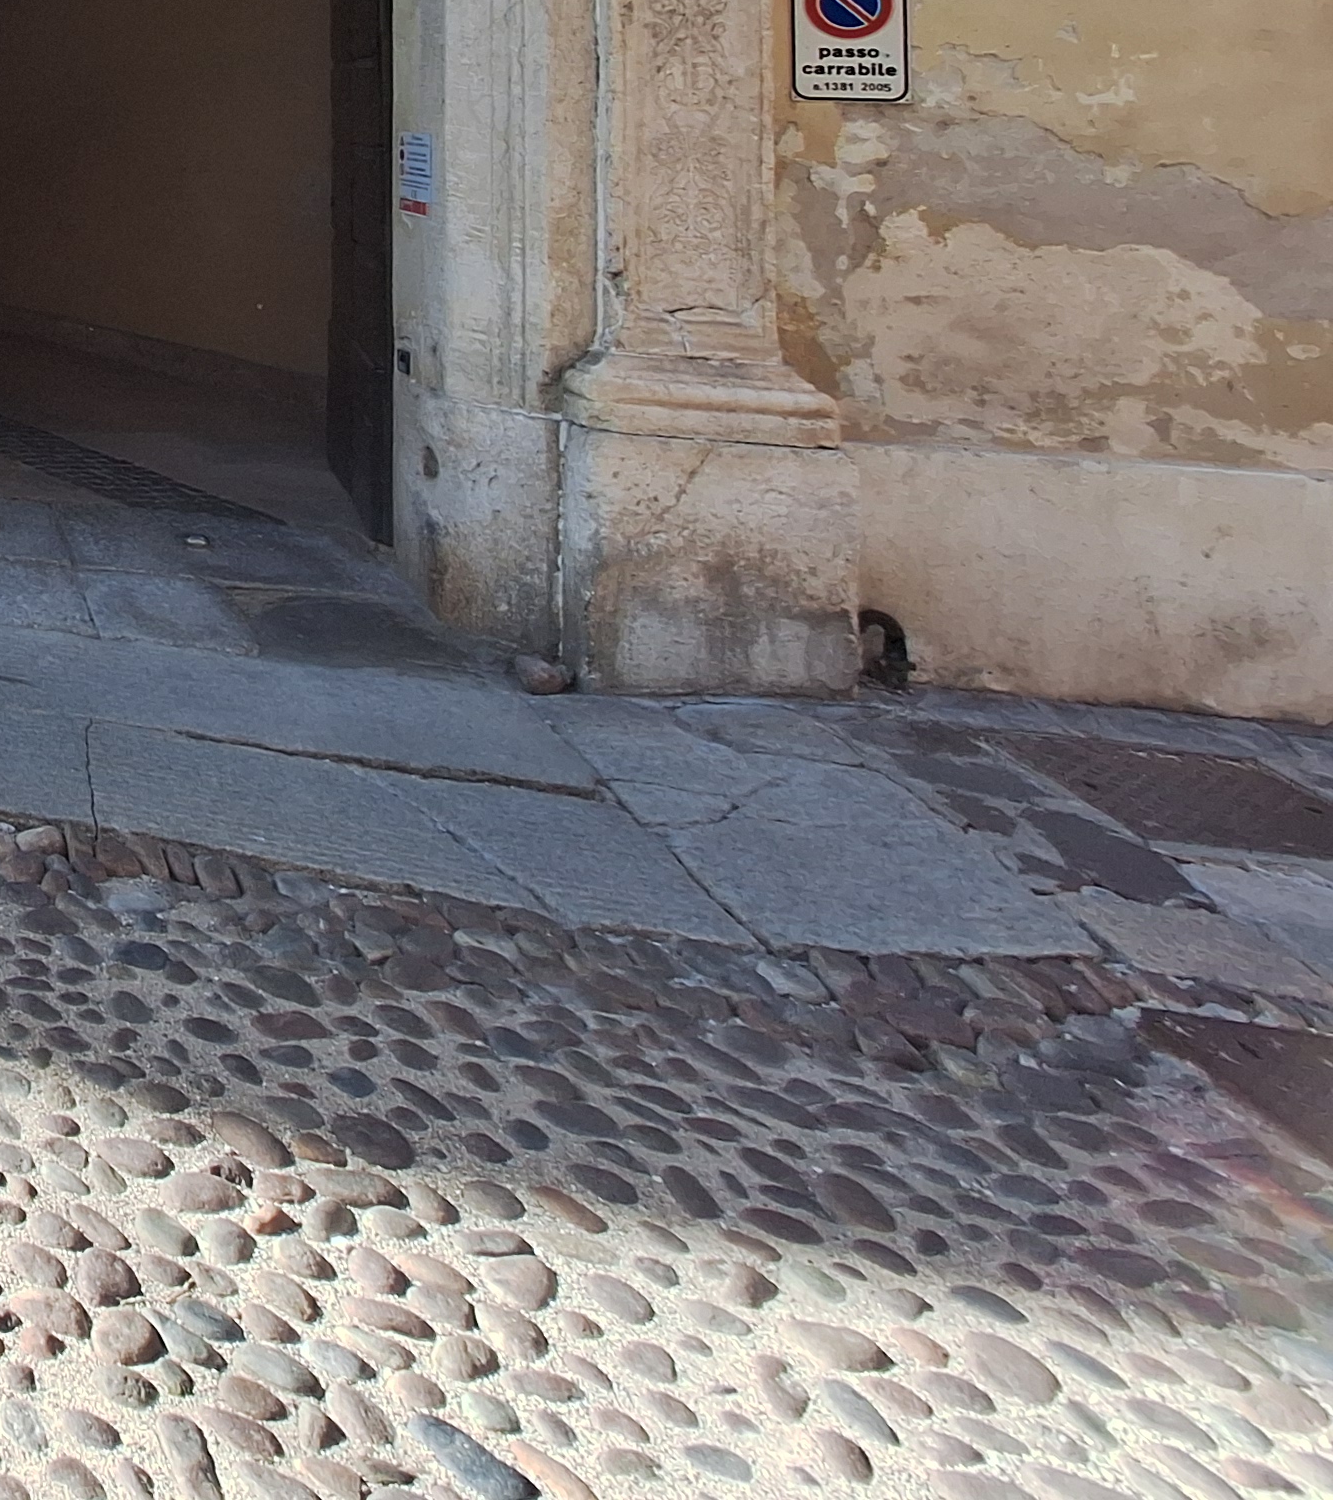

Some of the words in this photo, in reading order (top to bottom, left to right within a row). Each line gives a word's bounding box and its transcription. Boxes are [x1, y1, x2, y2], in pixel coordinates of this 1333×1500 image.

[818, 47, 880, 60] passo
[802, 63, 897, 76] carrabile
[861, 83, 892, 92] 2005
